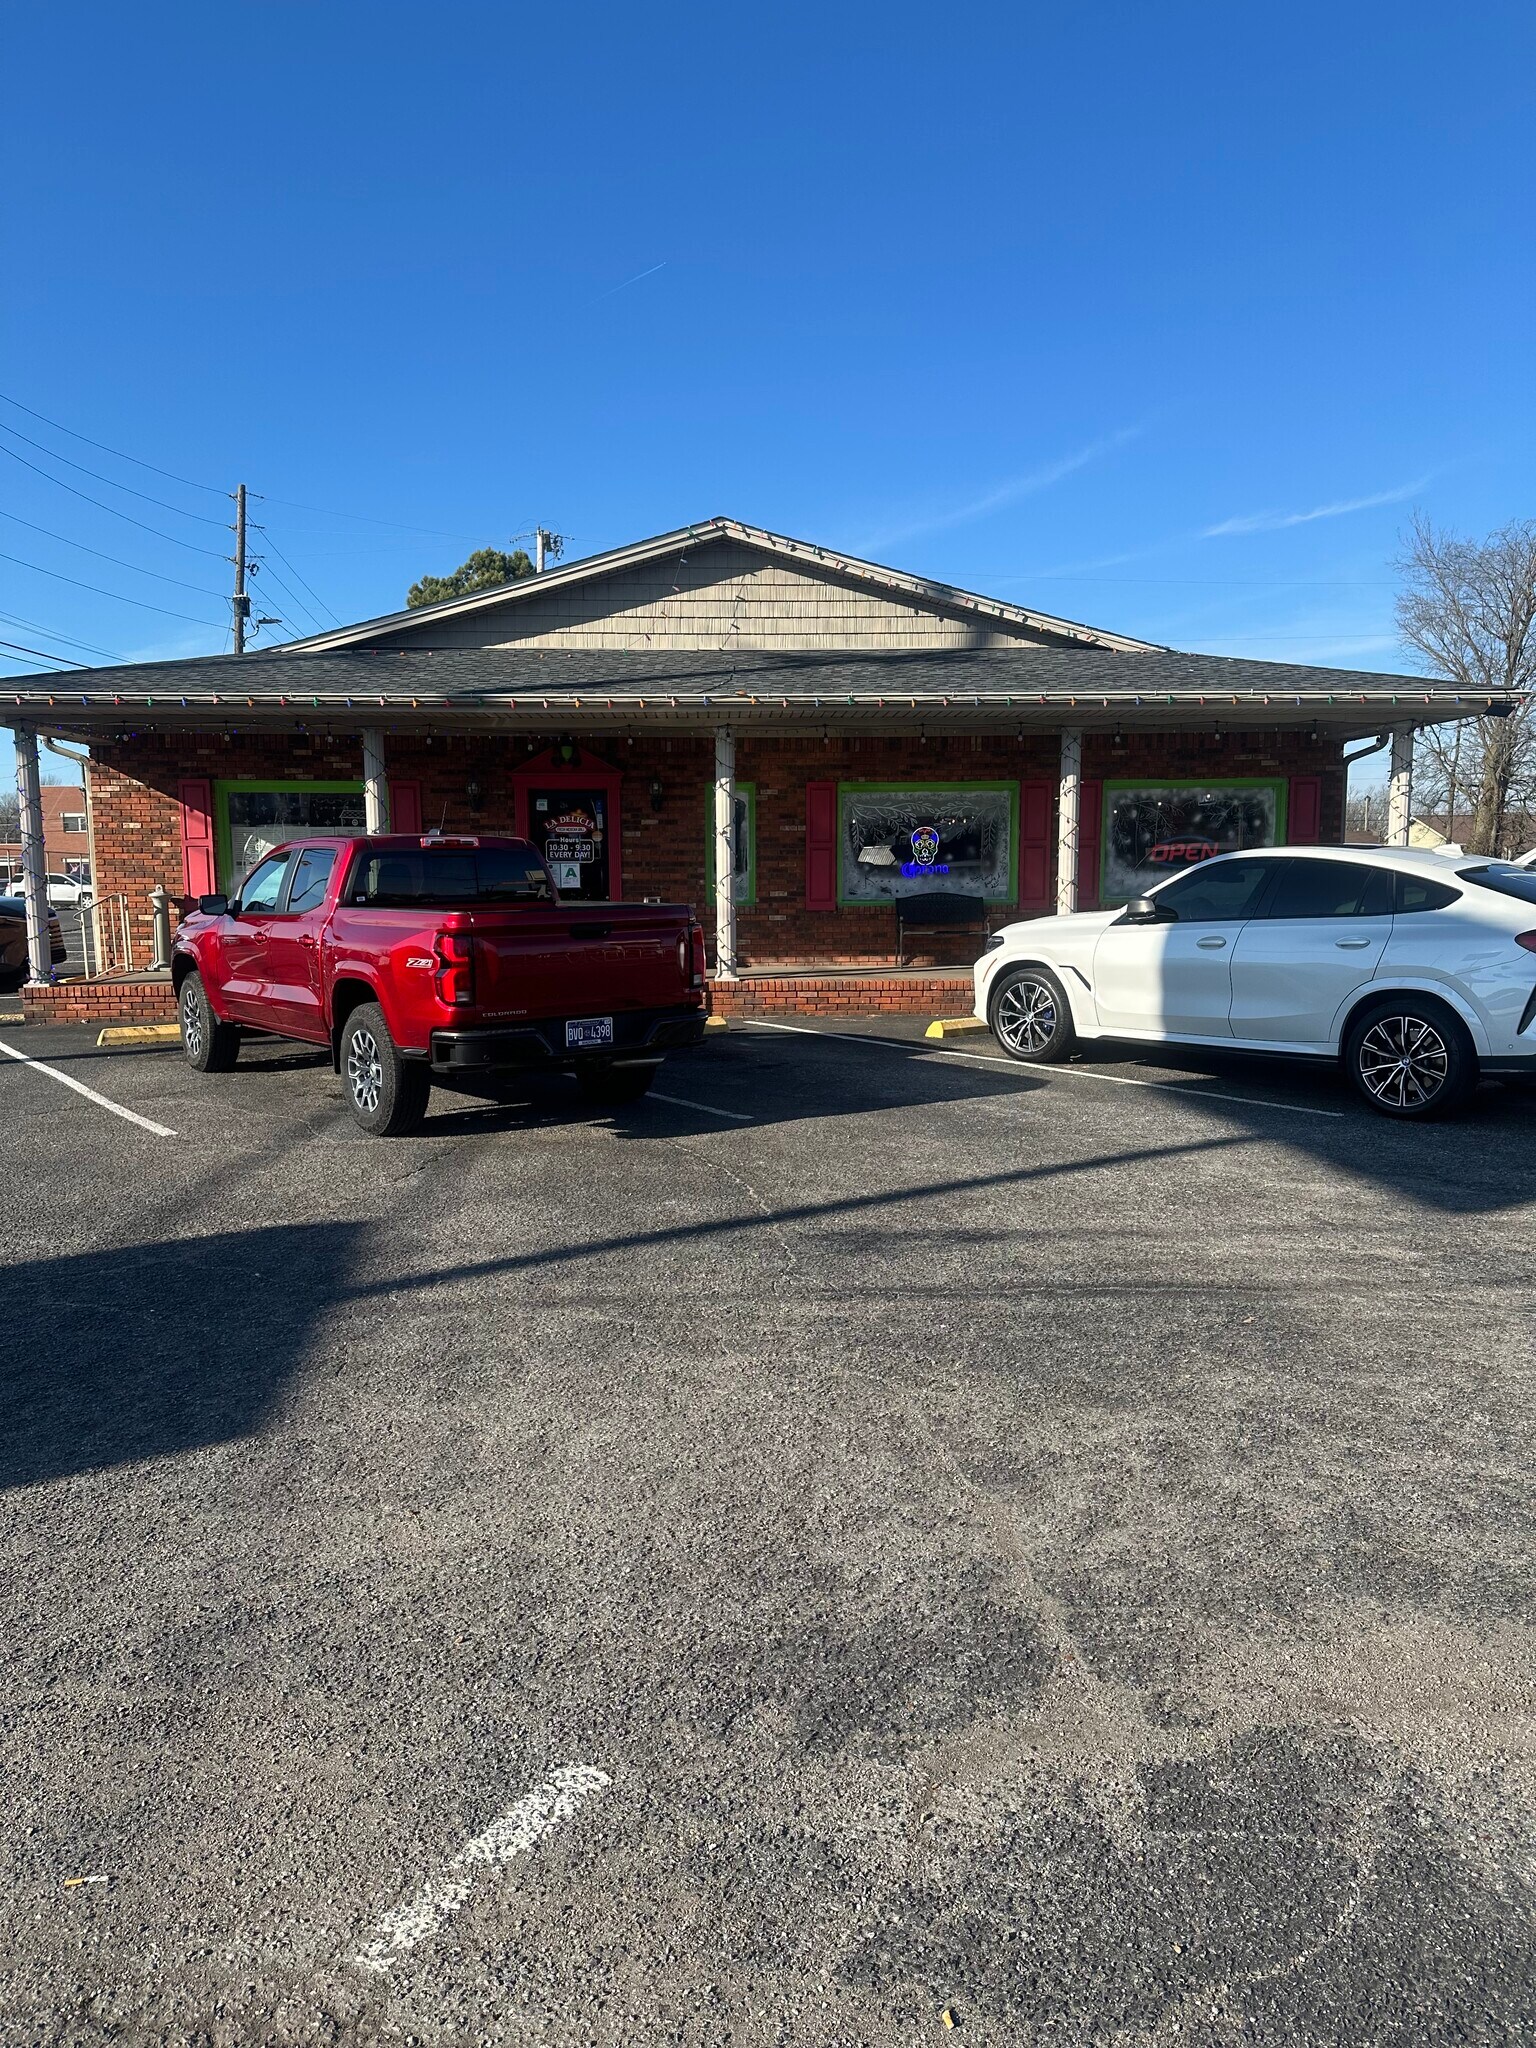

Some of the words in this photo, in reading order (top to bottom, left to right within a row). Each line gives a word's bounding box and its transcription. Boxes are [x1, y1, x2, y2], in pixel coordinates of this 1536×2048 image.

[545, 819, 558, 829] LA
[559, 815, 595, 829] DELICIA
[1151, 842, 1220, 862] OPEN
[565, 867, 577, 877] A
[901, 862, 950, 879] Corona
[482, 1009, 528, 1018] COLORADO
[591, 1025, 611, 1038] 4398
